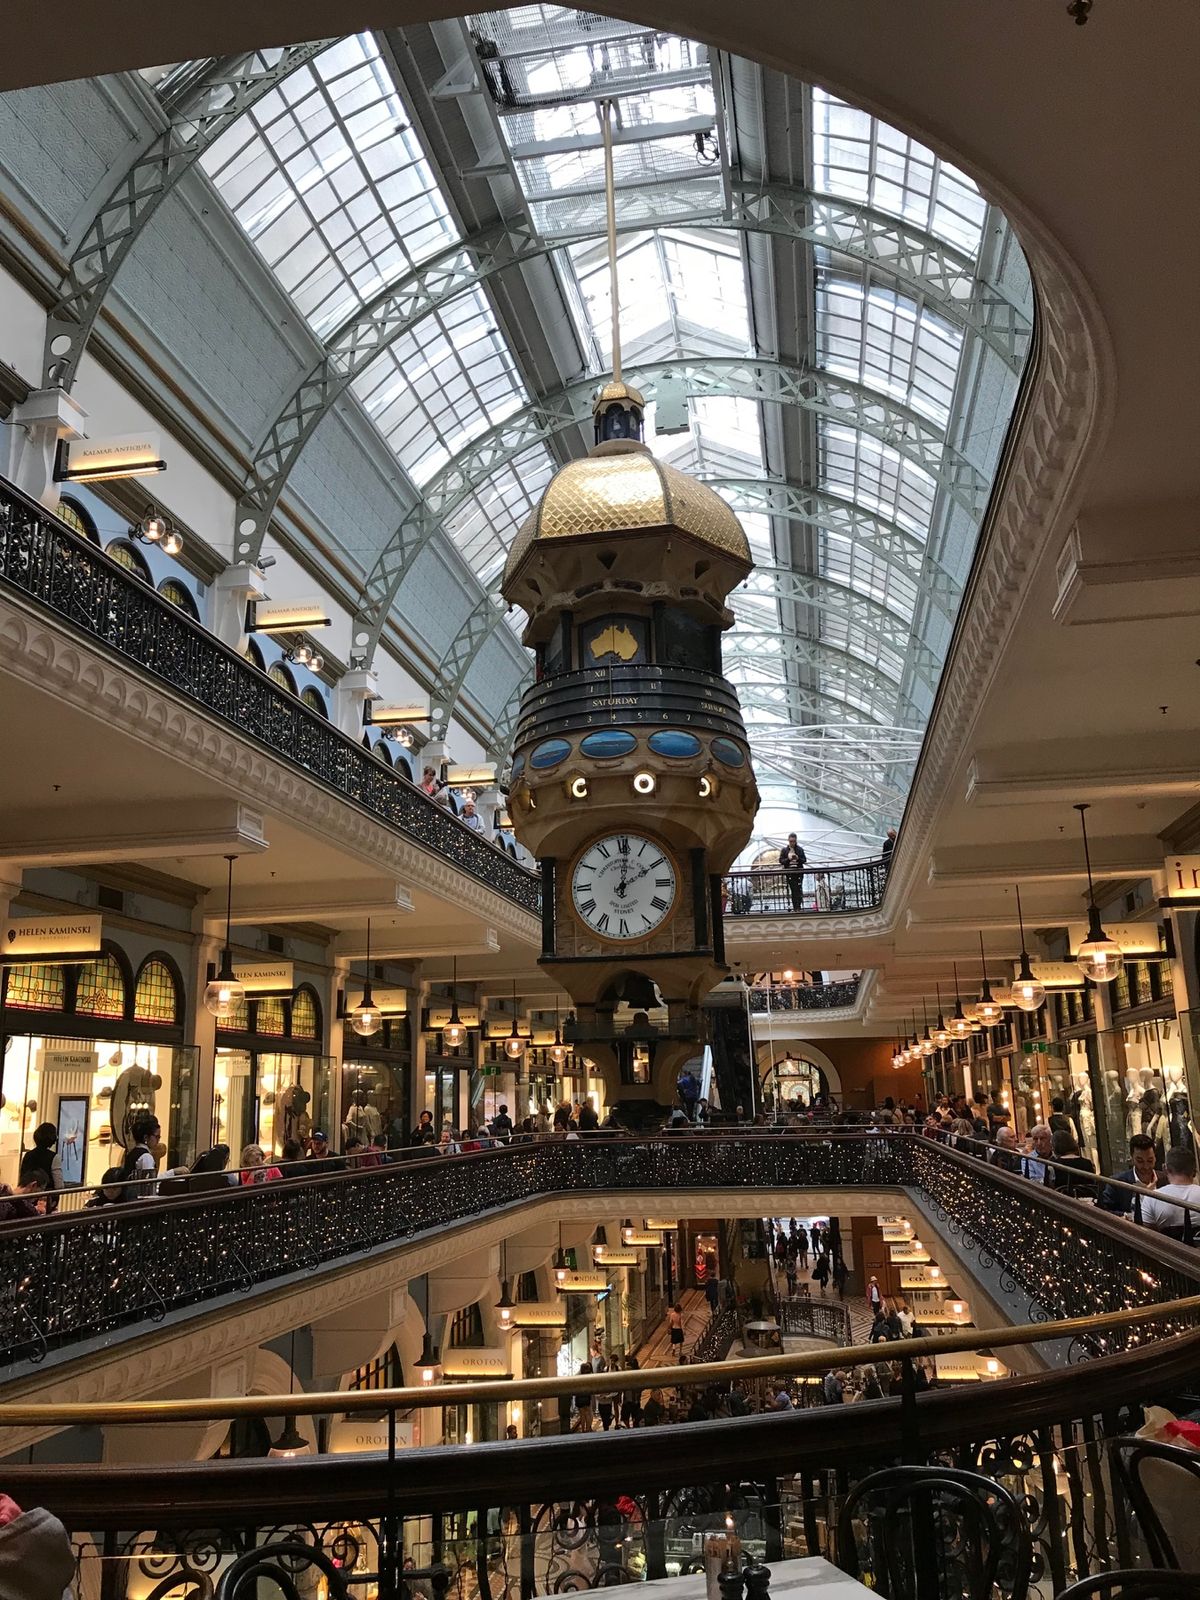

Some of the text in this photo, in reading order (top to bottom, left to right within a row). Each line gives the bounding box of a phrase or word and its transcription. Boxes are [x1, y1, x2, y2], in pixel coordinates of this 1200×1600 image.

[592, 696, 639, 707] SATURDAY
[18, 926, 91, 936] HELEN KAMINSKI
[254, 970, 287, 978] KAMINSKI
[462, 1358, 504, 1366] OROTON
